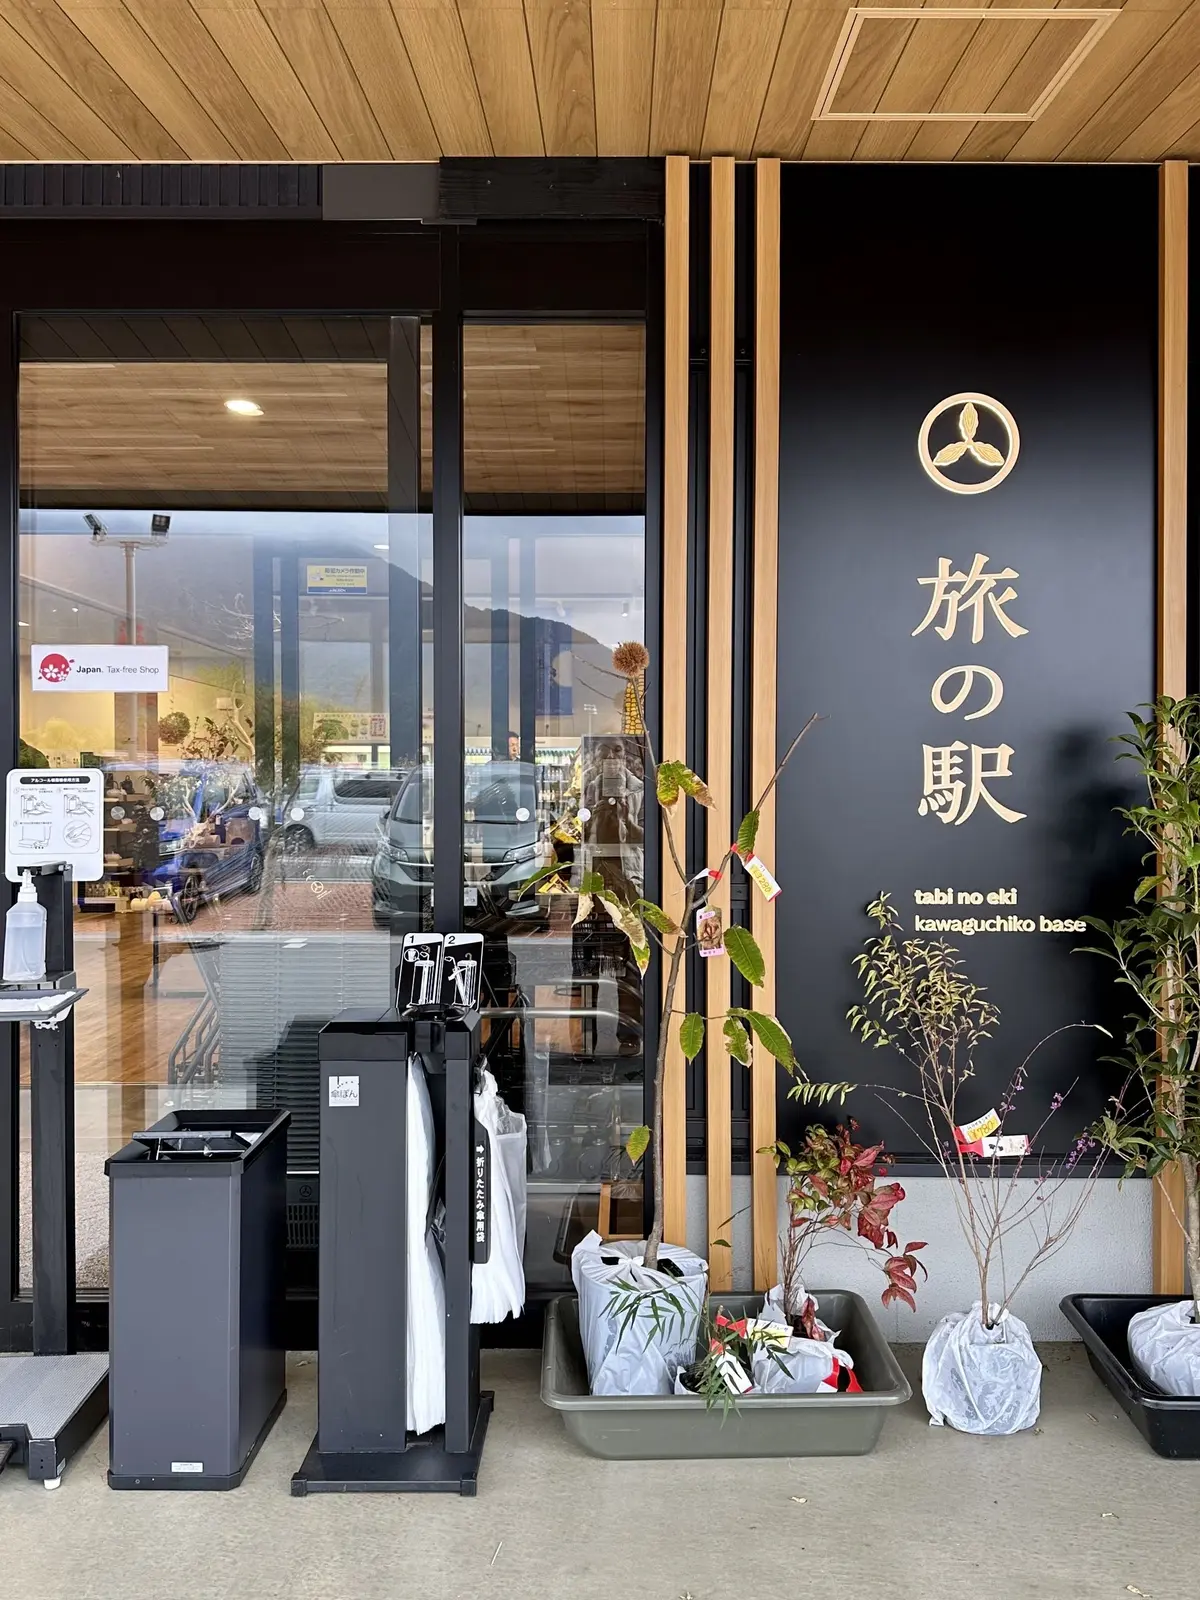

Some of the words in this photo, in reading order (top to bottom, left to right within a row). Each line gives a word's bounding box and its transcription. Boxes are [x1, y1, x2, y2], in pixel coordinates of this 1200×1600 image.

[76, 665, 104, 674] Japan.
[107, 665, 137, 674] Tax-free
[139, 665, 159, 675] Shop
[911, 552, 1029, 827] 旅の駅
[914, 888, 953, 905] tabi
[957, 891, 984, 905] no
[987, 888, 1018, 905] eki
[914, 915, 1036, 936] kawaguchiko
[1039, 915, 1087, 932] base
[409, 935, 415, 944] 1
[447, 935, 456, 945] 2
[475, 1157, 486, 1243] 折りたたみ傘用袋
